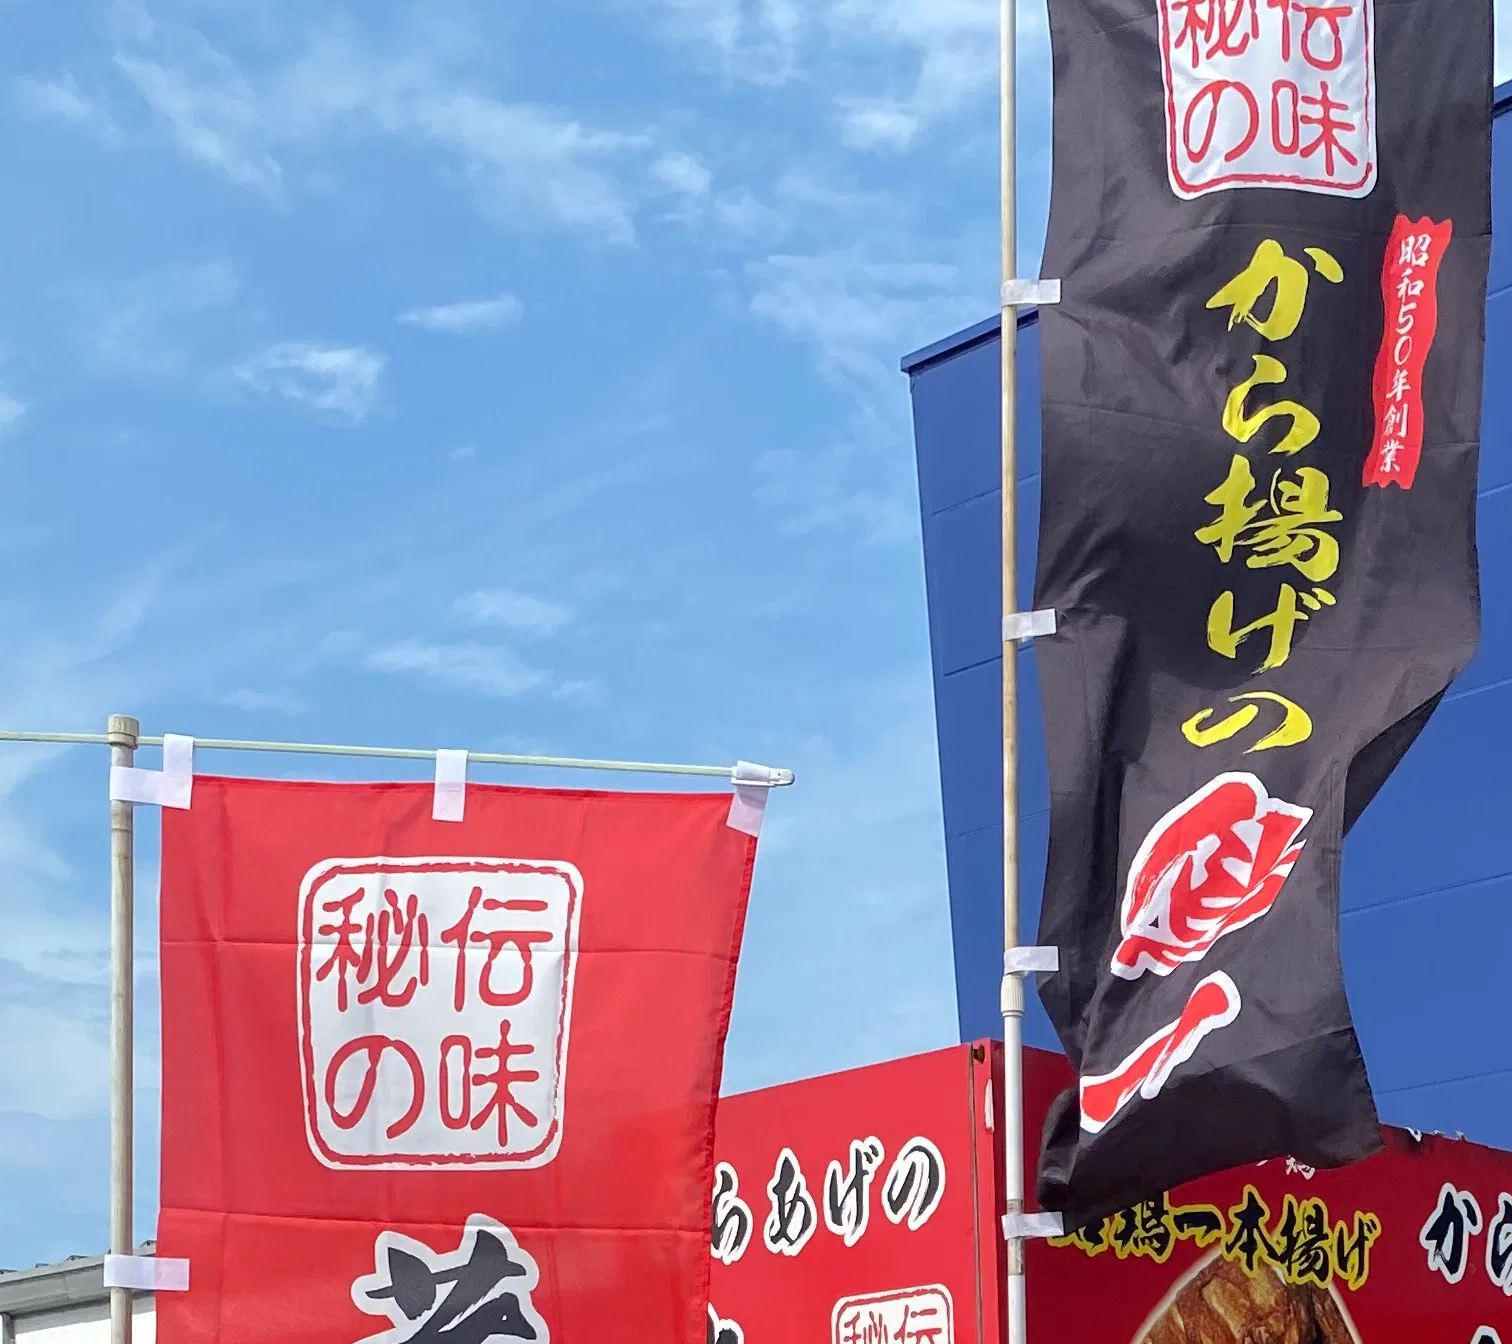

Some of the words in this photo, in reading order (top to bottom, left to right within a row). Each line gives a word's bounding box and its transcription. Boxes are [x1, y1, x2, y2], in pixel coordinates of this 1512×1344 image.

[1182, 79, 1359, 178] の味
[1380, 234, 1433, 473] 昭和50年創業
[1181, 238, 1344, 754] から揚げの
[314, 885, 554, 1013] 秘伝
[324, 1020, 541, 1148] の味
